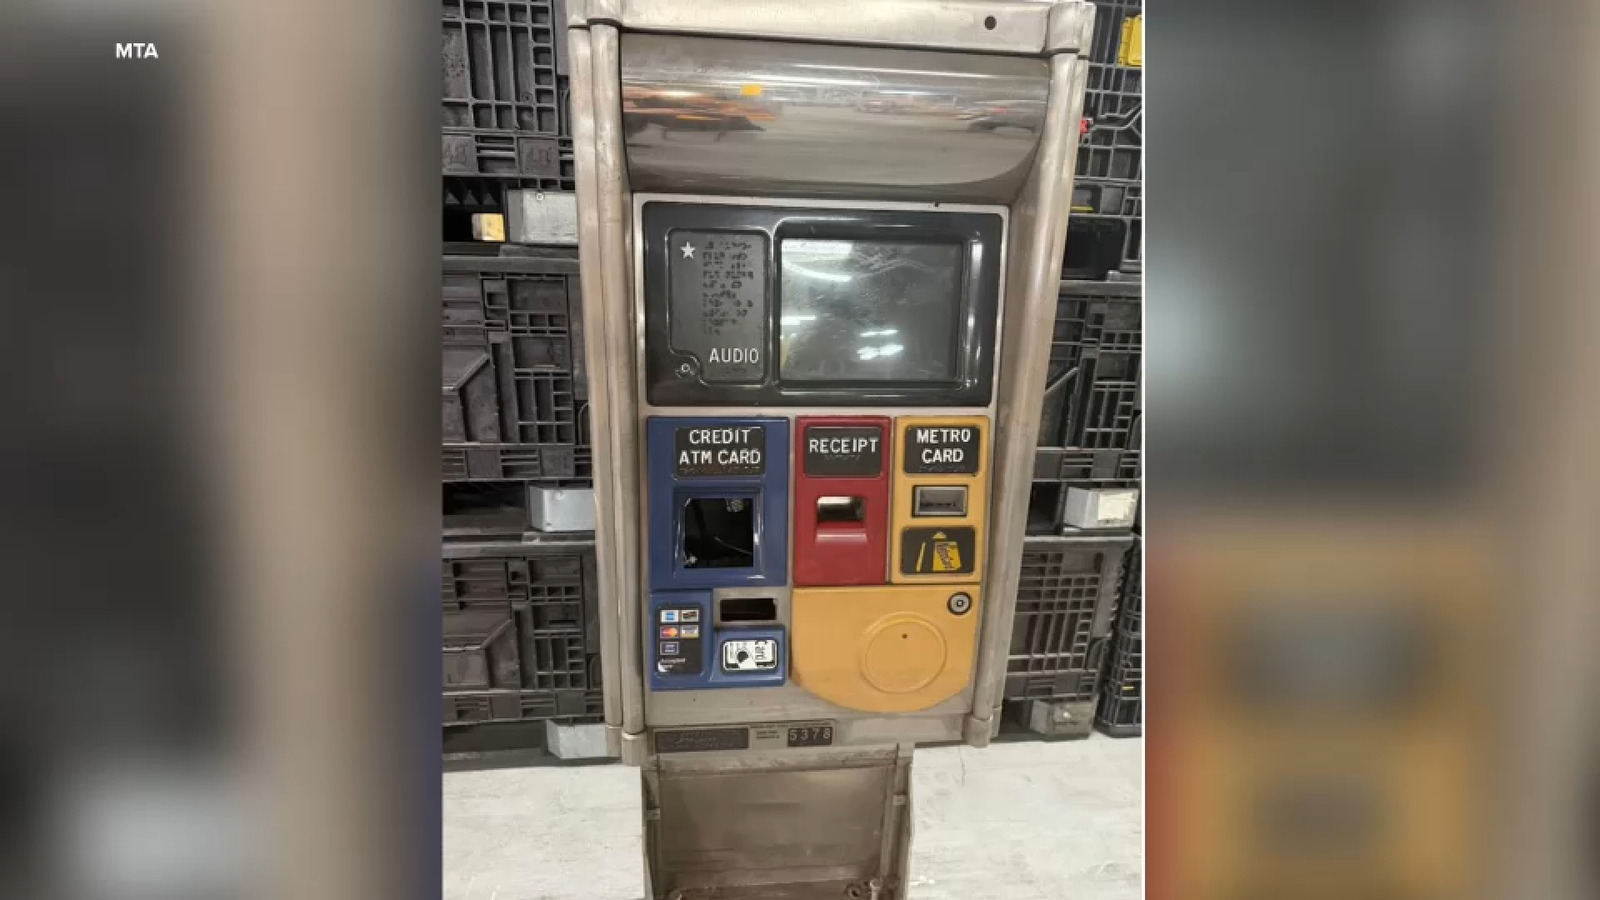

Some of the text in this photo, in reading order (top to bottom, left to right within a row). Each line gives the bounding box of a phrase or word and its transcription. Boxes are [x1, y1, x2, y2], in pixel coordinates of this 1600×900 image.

[709, 347, 760, 364] AUDIO
[689, 427, 751, 444] CREDIT
[916, 427, 971, 444] METRO
[808, 437, 879, 453] RECEIPT
[679, 448, 761, 465] ATM CARD
[921, 447, 964, 464] CARD
[789, 727, 831, 741] 5378
